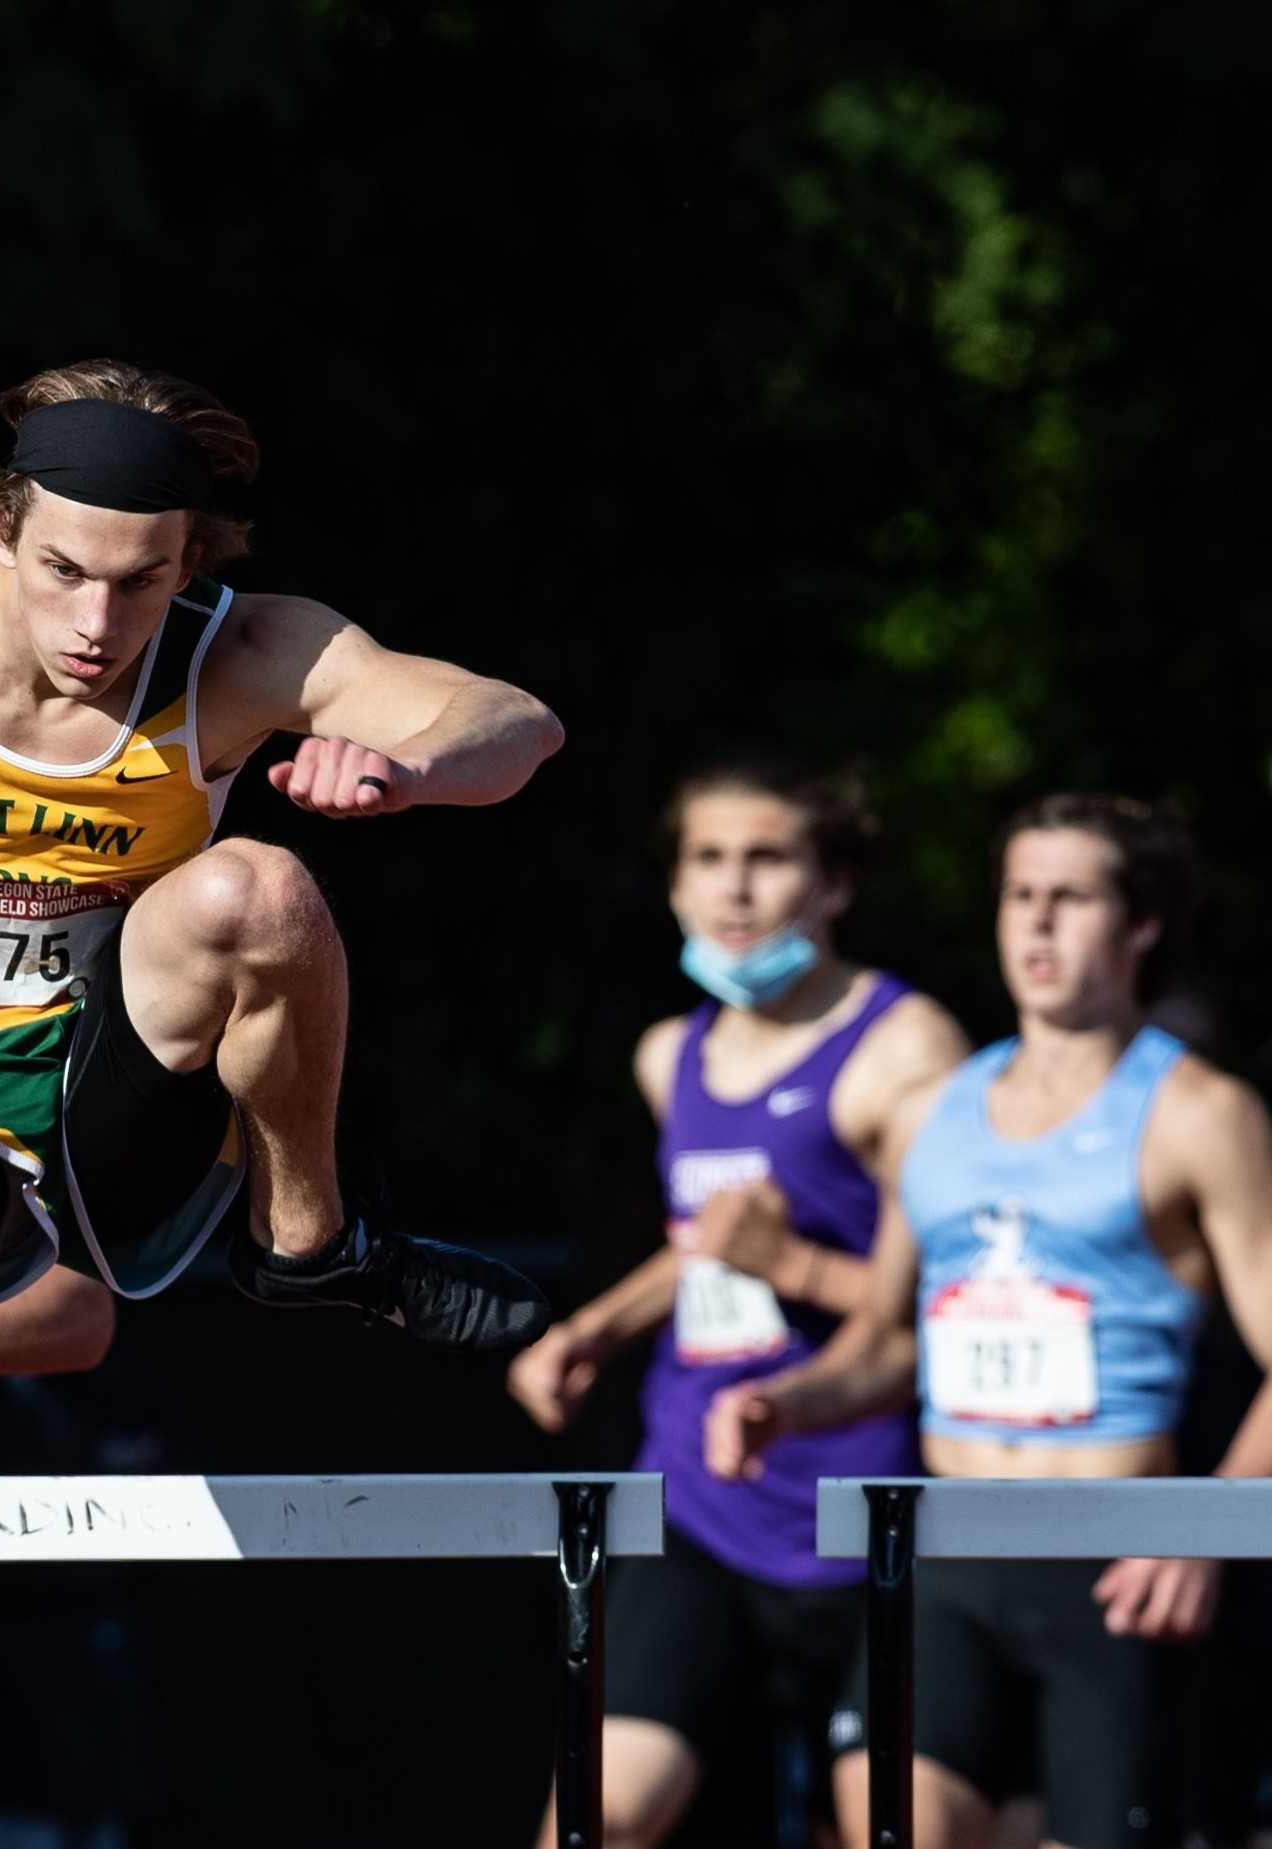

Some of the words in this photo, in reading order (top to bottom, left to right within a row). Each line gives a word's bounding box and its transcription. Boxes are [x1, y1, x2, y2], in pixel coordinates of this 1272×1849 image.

[29, 803, 146, 856] LINN
[35, 884, 78, 901] STATE
[29, 894, 104, 917] SHOWCASE
